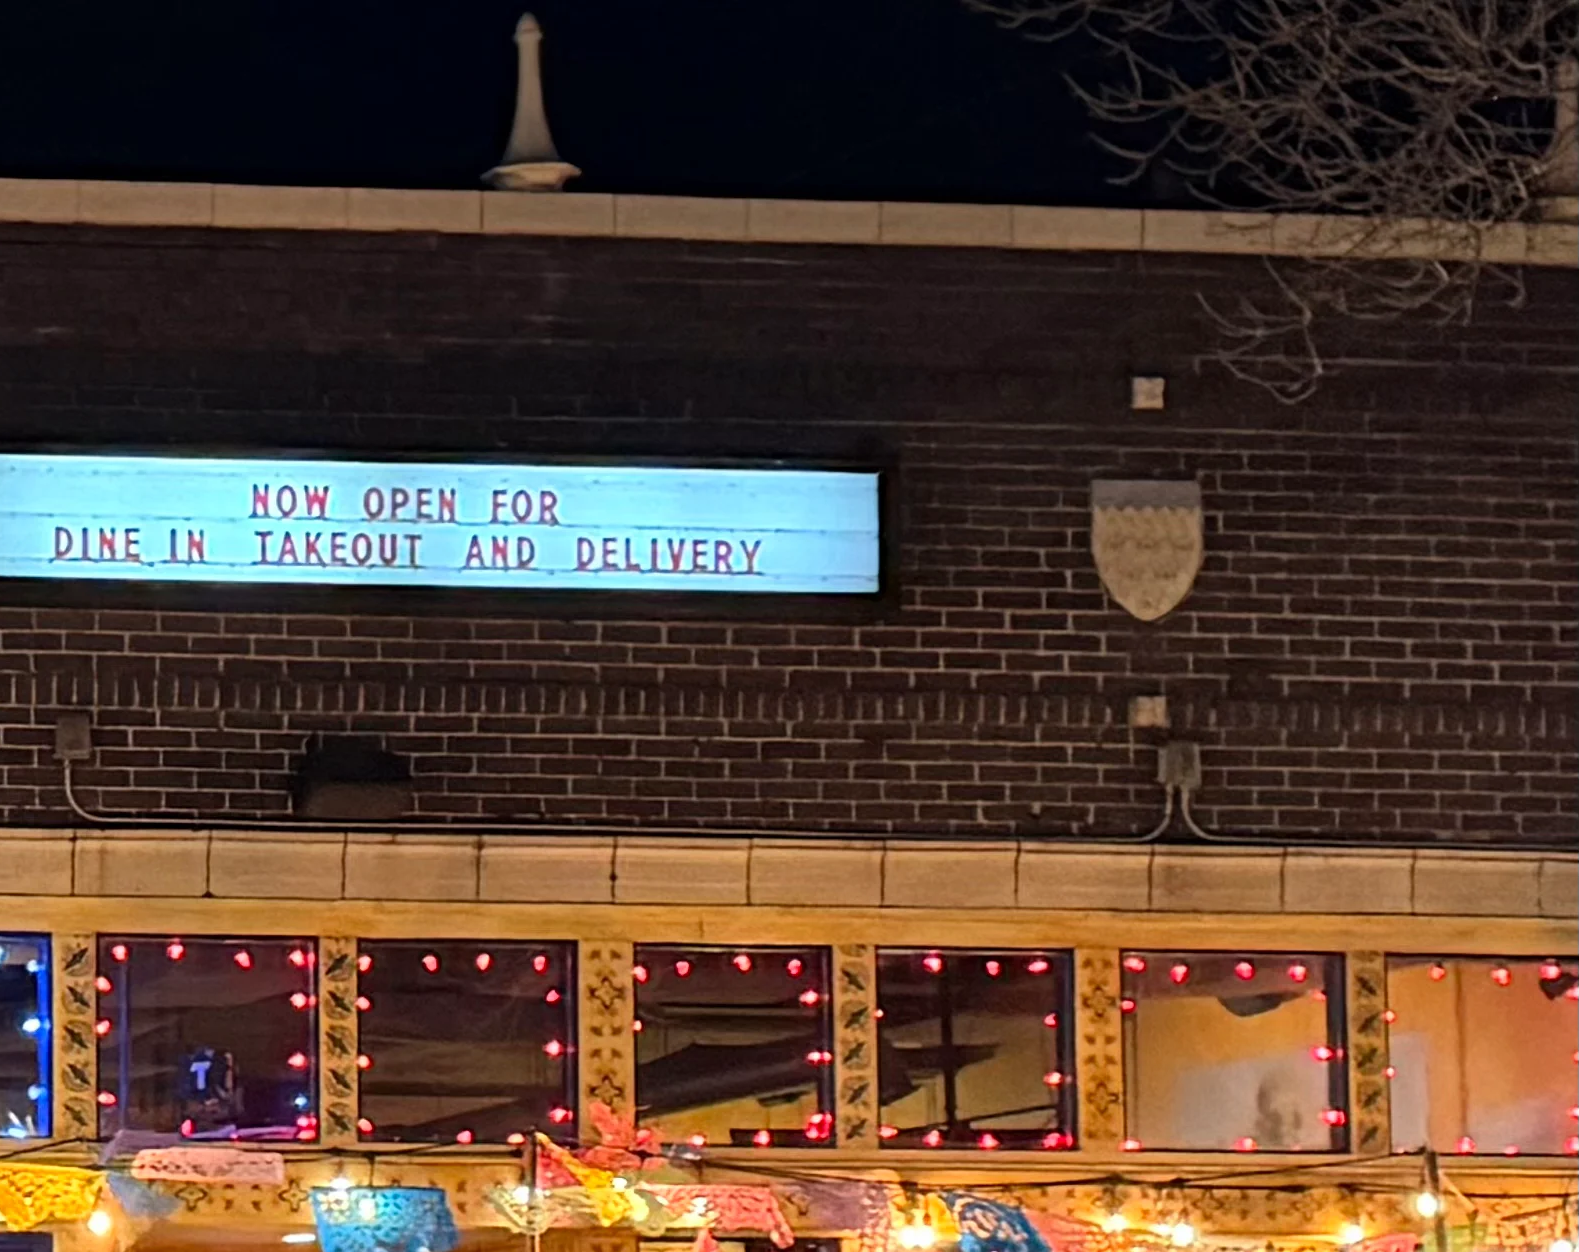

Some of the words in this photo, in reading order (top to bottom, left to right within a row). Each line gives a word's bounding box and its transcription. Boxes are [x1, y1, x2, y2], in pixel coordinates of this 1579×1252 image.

[252, 484, 330, 519] NOW
[363, 487, 457, 524] OPEN
[492, 489, 559, 526] FOR
[54, 526, 142, 562] DINE
[168, 528, 205, 564] IN
[253, 530, 423, 568] TAKEOUT
[465, 534, 536, 570] AND
[576, 537, 762, 574] DELIVERY
